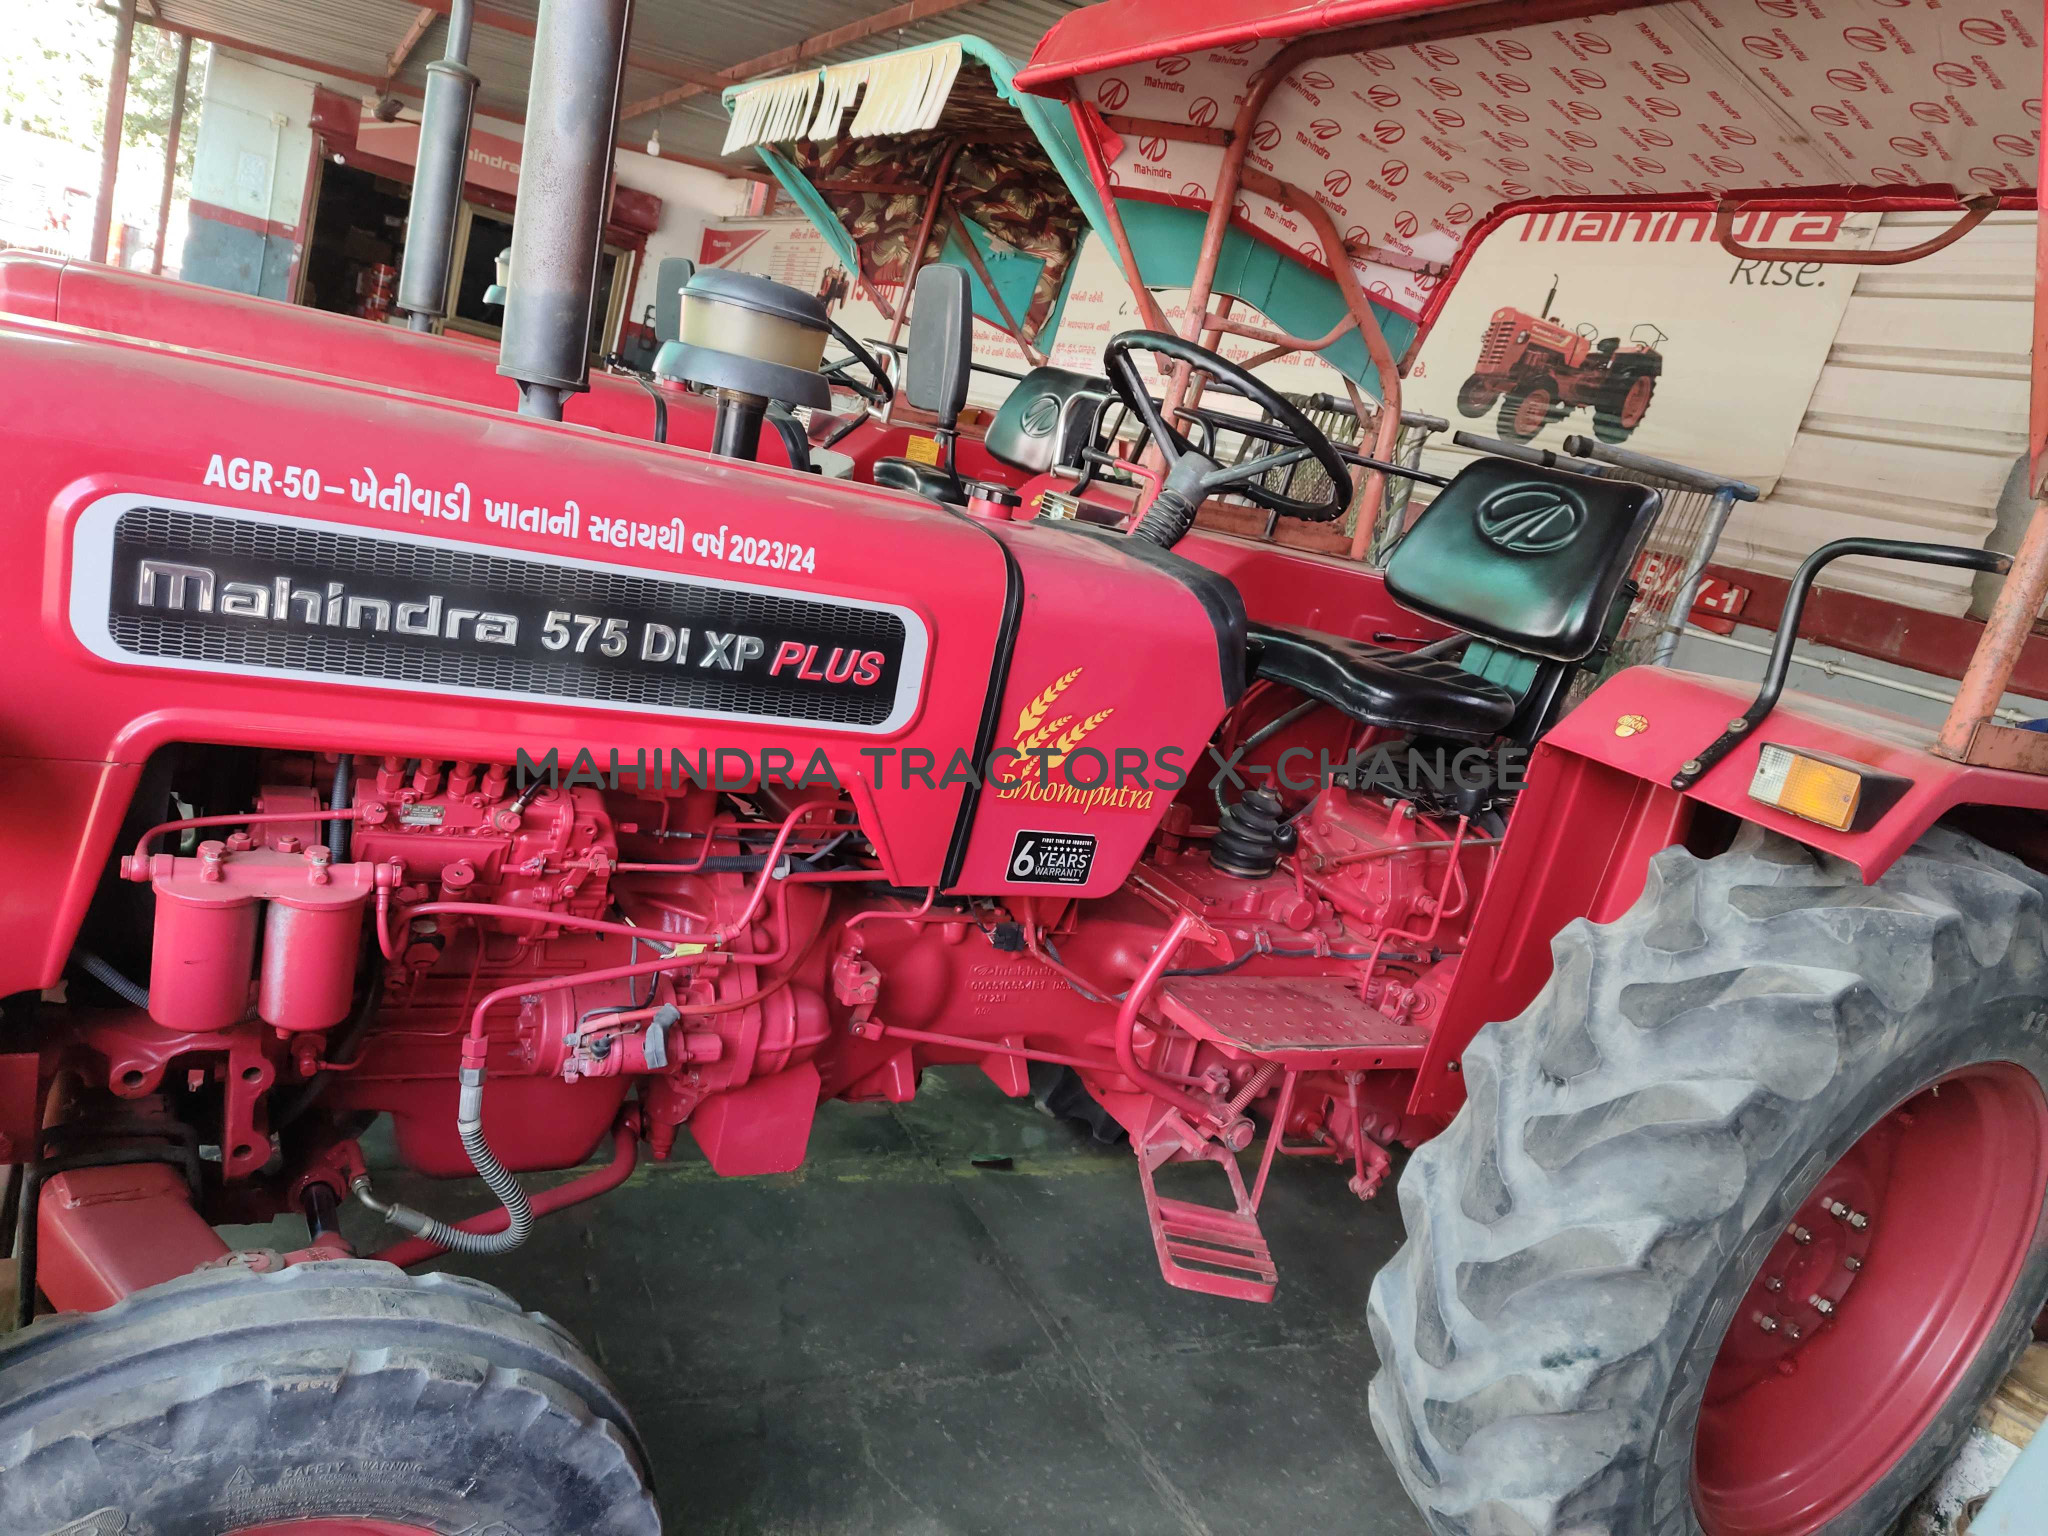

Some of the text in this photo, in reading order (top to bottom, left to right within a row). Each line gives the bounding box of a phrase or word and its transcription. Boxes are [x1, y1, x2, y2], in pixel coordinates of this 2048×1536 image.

[203, 454, 320, 501] AGR-50
[350, 467, 470, 522] ખેતીવાડી
[484, 498, 580, 539] ખાતાની
[588, 515, 685, 554] સહાયથી
[692, 525, 728, 560] વર્ષ
[728, 535, 816, 574] 2023/24
[541, 610, 629, 658] 575
[641, 622, 691, 665] DI
[699, 630, 765, 672] XP
[769, 640, 886, 686] PLUS
[997, 773, 1154, 815] Bhoomiputra
[1013, 840, 1035, 877] 6
[1035, 866, 1084, 878] WARRANTY
[284, 1460, 424, 1477] SAFETY WARNING
